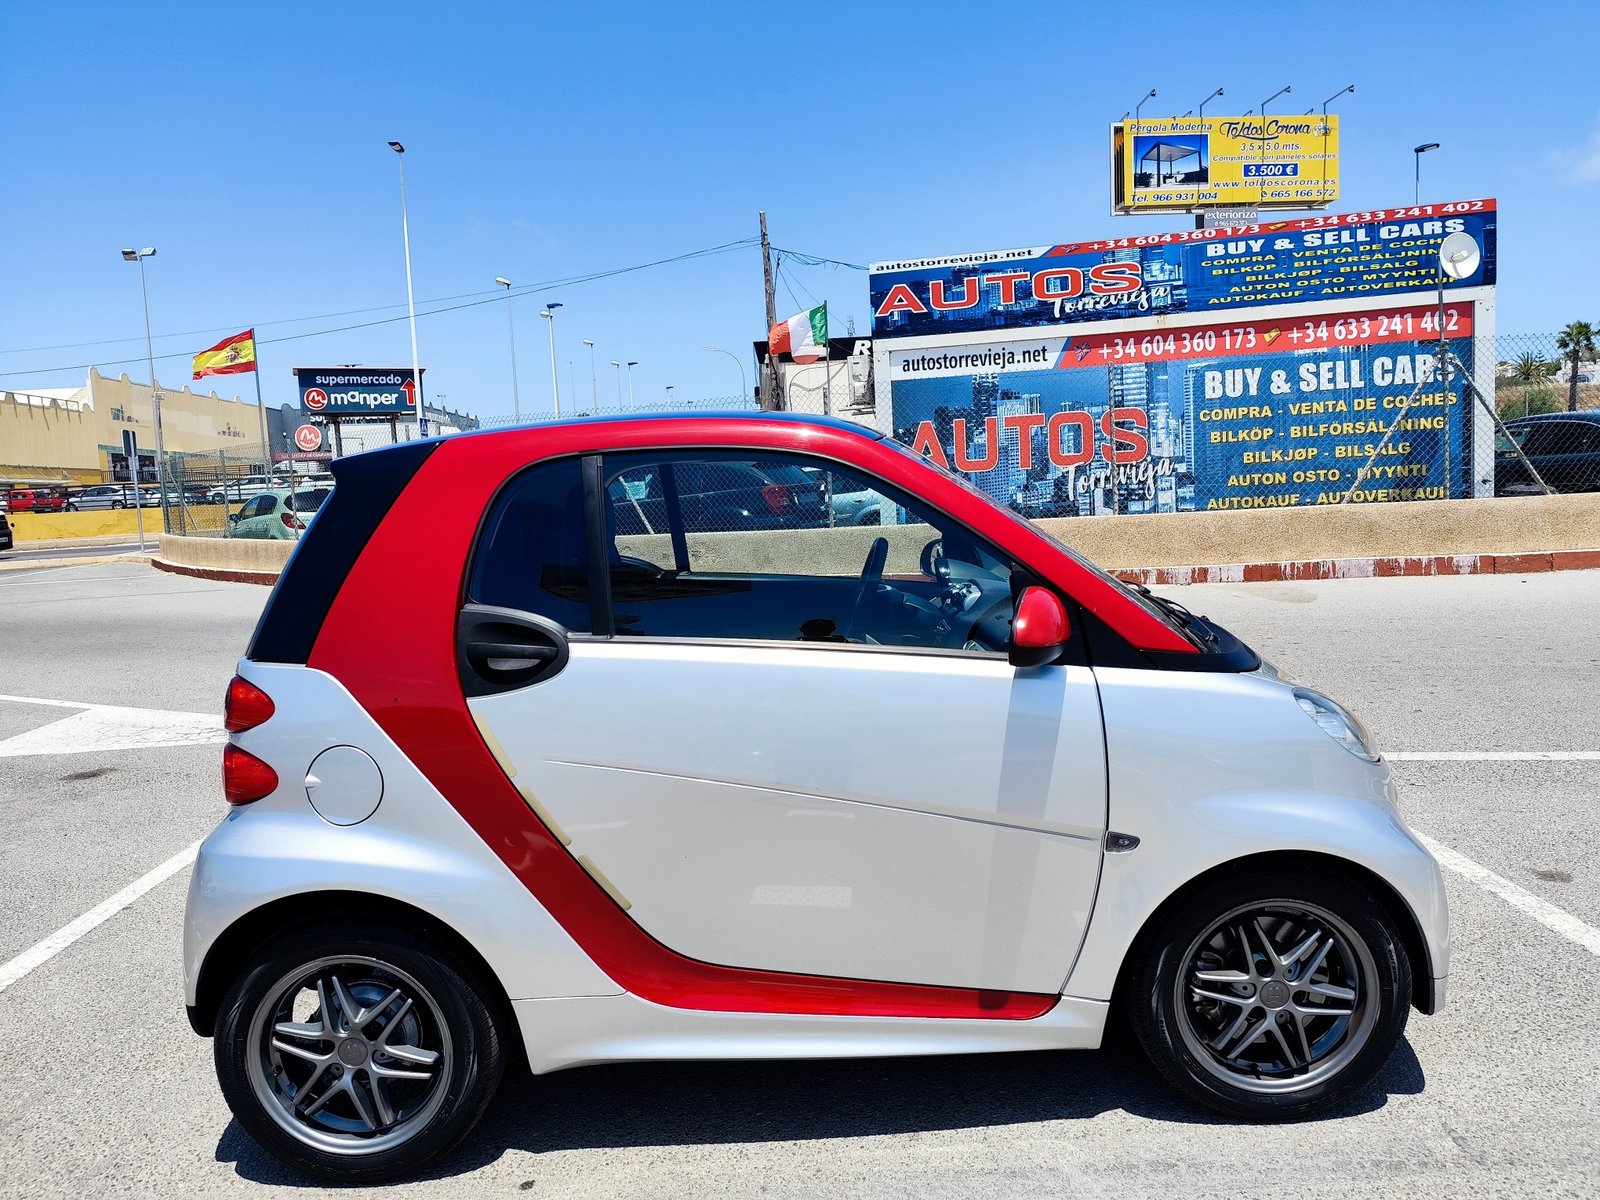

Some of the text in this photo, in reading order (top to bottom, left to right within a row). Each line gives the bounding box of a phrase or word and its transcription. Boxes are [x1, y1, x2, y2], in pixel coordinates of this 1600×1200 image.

[1130, 123, 1212, 133] Pergola Moderna
[1220, 120, 1311, 139] Toldos Corona
[1276, 153, 1306, 161] paneles
[1248, 165, 1294, 176] 3.500 €
[1213, 179, 1336, 188] www.toldoscorona.es
[1271, 189, 1335, 198] 665 166 572
[1131, 192, 1217, 202] Tel. 966 931 004
[1205, 210, 1257, 219] exterioriza
[1294, 201, 1484, 228] +34 633 241 402
[1088, 225, 1260, 250] +34 604 360 173
[1206, 219, 1465, 257] BUY & SELL CARS
[876, 249, 1034, 272] autostorrevieja.net
[1201, 254, 1276, 267] COMPRA
[1292, 247, 1352, 258] VENTA
[1389, 237, 1446, 248] COCH
[1212, 264, 1277, 275] BILKÖP
[1293, 249, 1439, 268] BILFÖRSÄLJNIN
[1230, 282, 1290, 293] AUTON
[1296, 277, 1345, 286] OSTO
[1362, 268, 1436, 280] MYYNTI
[1245, 269, 1322, 282] BILKJØP
[1340, 260, 1418, 273] BILSALG
[875, 262, 1142, 317] AUTOS
[1208, 290, 1304, 304] AUTOKAUF
[1321, 276, 1456, 294] AUTOVERKAUF
[1047, 286, 1169, 318] Torrevieja
[1287, 309, 1459, 344] +34 633 241 402
[1098, 327, 1257, 360] +34 604 360 173
[902, 345, 1048, 372] autostorrevieja.net
[315, 374, 402, 386] supermercado
[1204, 367, 1262, 399] BUY
[1270, 369, 1291, 395] &
[1298, 359, 1364, 392] SELL
[330, 391, 398, 409] manper
[1200, 405, 1273, 421] COMPRA
[1288, 400, 1348, 415] VENTA
[1354, 398, 1376, 411] DE
[911, 407, 1149, 473] AUTOS
[1210, 427, 1274, 443] BILKÖP
[1290, 416, 1444, 438] BILFÖRSÄLNING
[1243, 447, 1318, 464] BILKJØP
[1066, 456, 1174, 501] Torrvieja
[1227, 472, 1287, 486] AUTON
[1293, 469, 1340, 483] OSTO
[1207, 494, 1300, 510] AUTOKAUF
